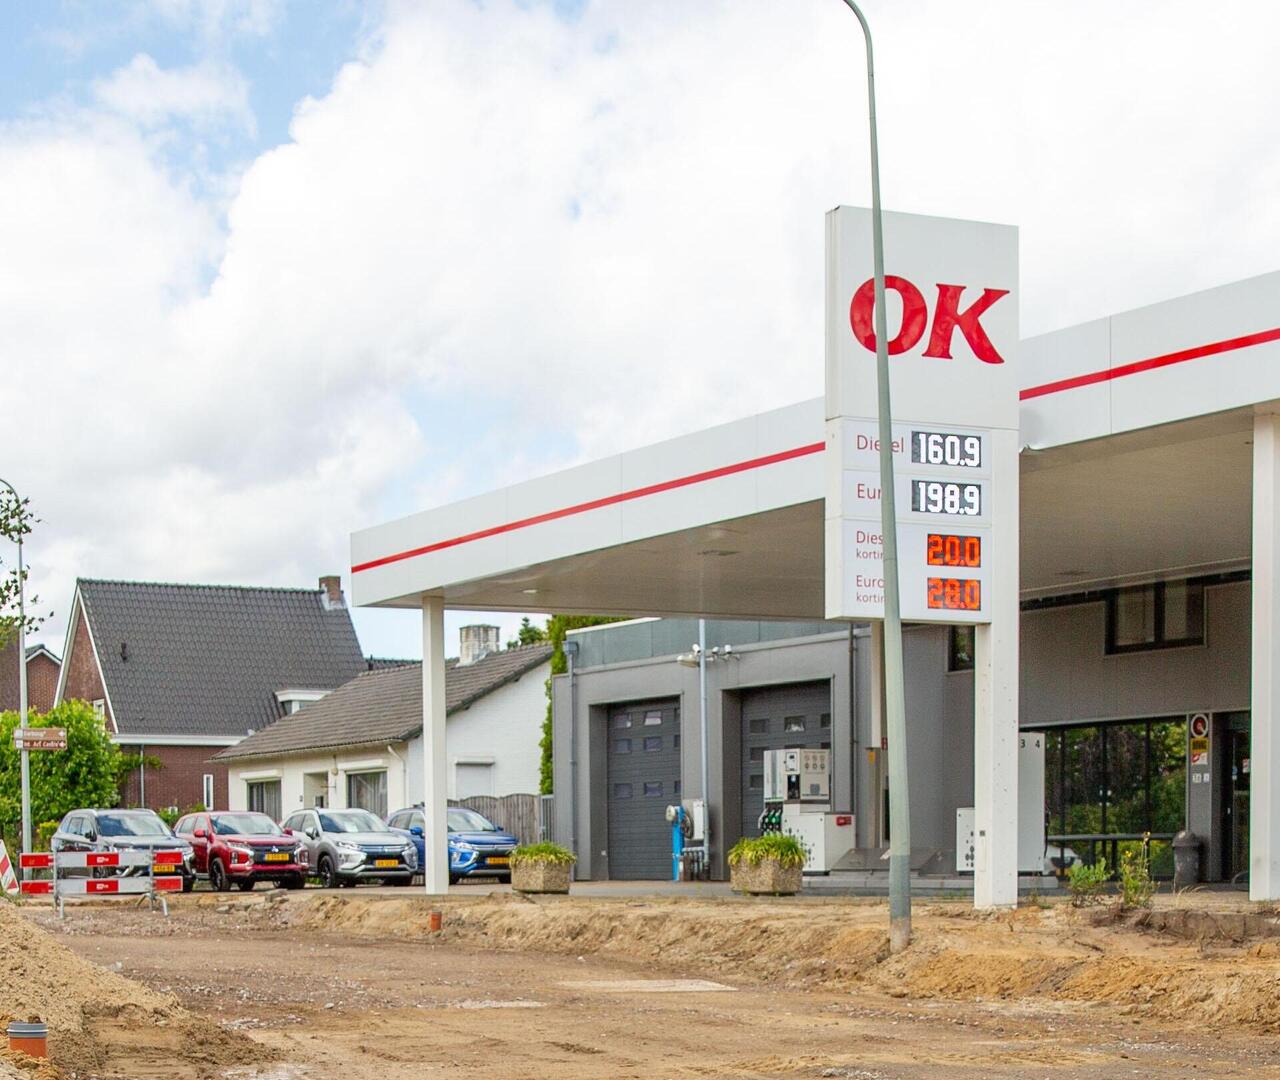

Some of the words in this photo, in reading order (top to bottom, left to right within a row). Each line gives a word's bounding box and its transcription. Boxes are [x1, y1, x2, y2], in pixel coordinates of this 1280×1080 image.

[849, 275, 1010, 364] OK
[857, 434, 904, 453] Dieel
[918, 433, 980, 467] 160.9
[857, 483, 882, 500] Eur
[918, 482, 980, 515] 198.9
[856, 530, 884, 545] Dies
[928, 535, 980, 567] 20.0
[928, 578, 980, 609] 28.0
